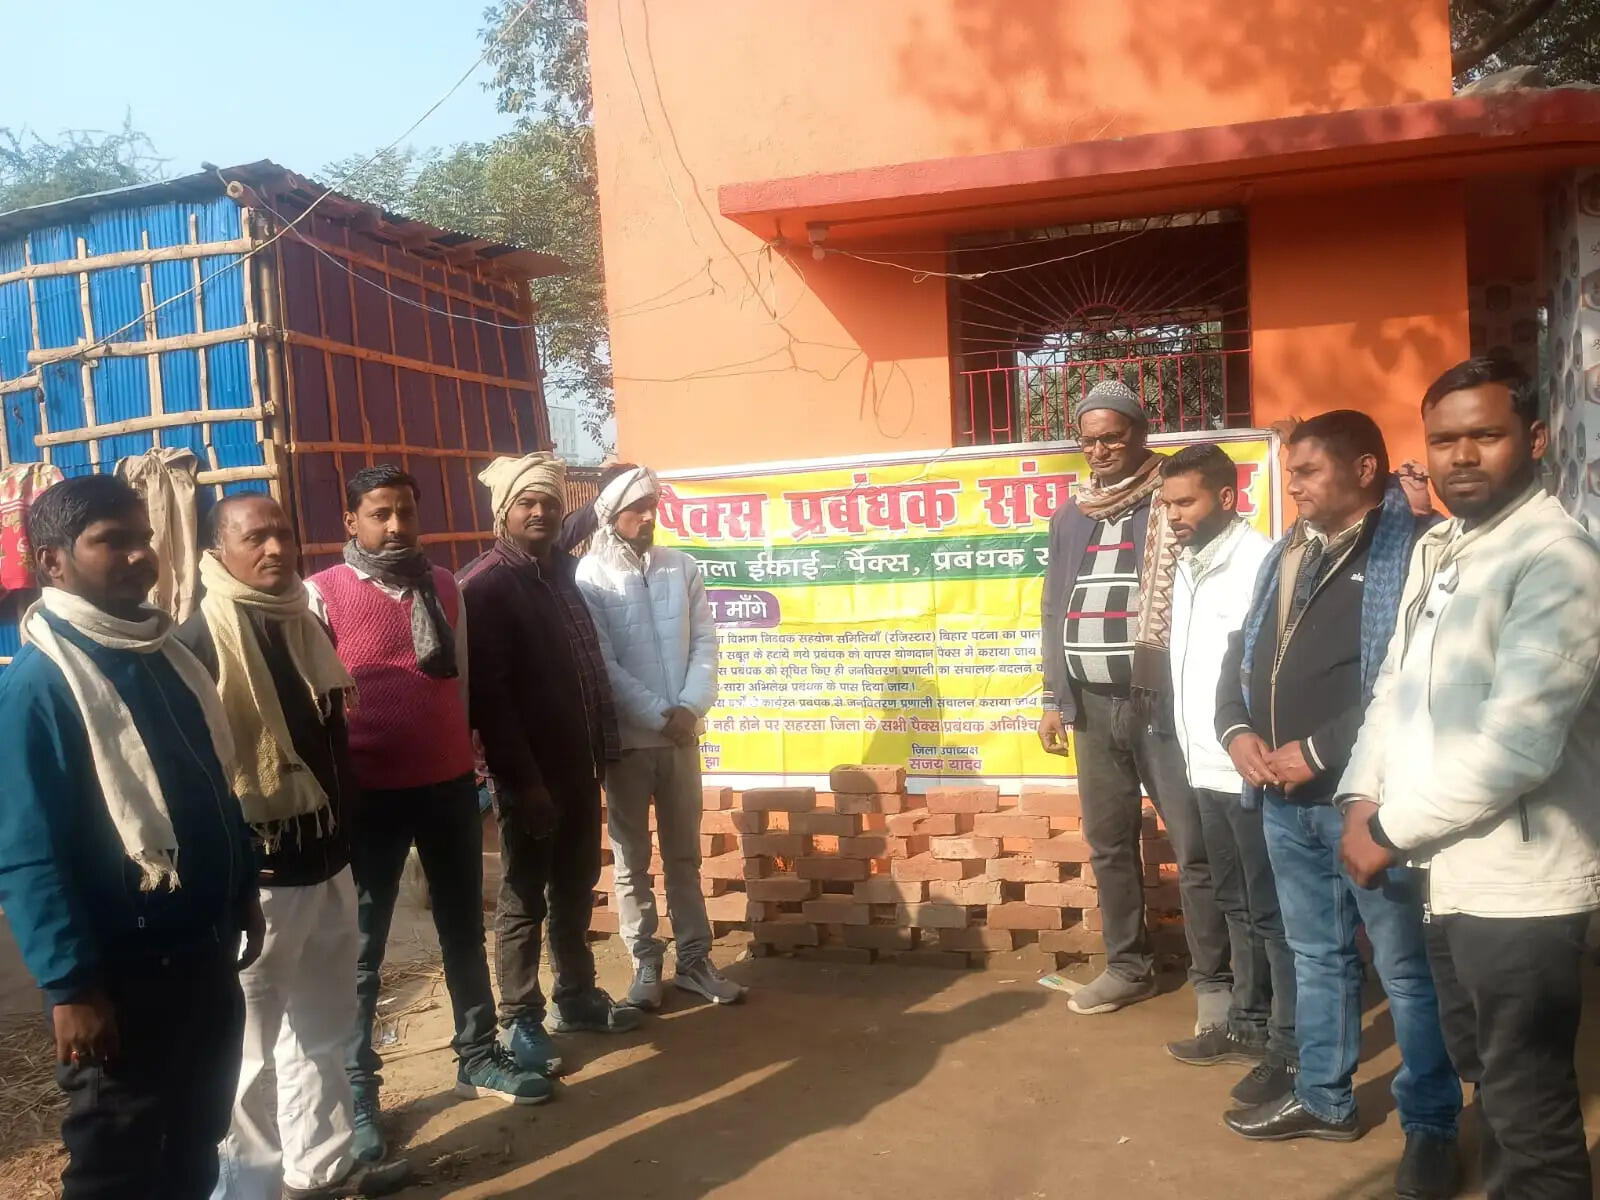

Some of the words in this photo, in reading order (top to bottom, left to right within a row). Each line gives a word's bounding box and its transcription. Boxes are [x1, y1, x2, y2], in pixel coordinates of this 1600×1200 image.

[657, 484, 768, 538] पैक्स
[783, 472, 959, 538] प्रबंधक
[931, 544, 1025, 571] प्रबंधक
[728, 632, 757, 643] विभाग
[799, 632, 833, 643] सहयोग
[836, 630, 881, 643] समितियाँ
[939, 629, 968, 641] बिहार
[971, 630, 998, 640] पटना
[1002, 630, 1016, 640] का
[726, 651, 749, 663] सबूत
[753, 648, 763, 659] के
[793, 647, 810, 659] गये
[813, 648, 845, 660] प्रबंधक
[848, 648, 859, 659] को
[864, 650, 891, 659] वापस
[894, 647, 933, 659] योगदान
[977, 648, 1010, 657] कराया
[765, 664, 776, 675] को
[780, 664, 808, 679] सूचित
[811, 664, 830, 675] किए
[834, 663, 844, 675] ही
[848, 664, 898, 675] जनवितरण
[901, 663, 934, 675] प्रणाली
[938, 665, 949, 674] का
[724, 683, 745, 691] सारा
[826, 680, 836, 690] के
[839, 683, 858, 691] पास
[862, 680, 884, 691] दिया
[834, 696, 842, 707] से
[847, 696, 897, 708] जनवितरण
[900, 696, 932, 708] प्रणाली
[978, 698, 1011, 707] कराया
[739, 716, 760, 731] होने
[764, 720, 779, 731] पर
[784, 720, 826, 731] सहरसा
[830, 715, 860, 730] जिला
[864, 716, 877, 730] के
[880, 716, 907, 732] सभी
[910, 716, 940, 732] पैक्स
[943, 718, 985, 732] प्रबंधक
[990, 715, 1041, 731] अनिश्चि
[912, 743, 936, 755] जिला
[909, 756, 944, 769] संजय
[948, 759, 982, 770] यादव
